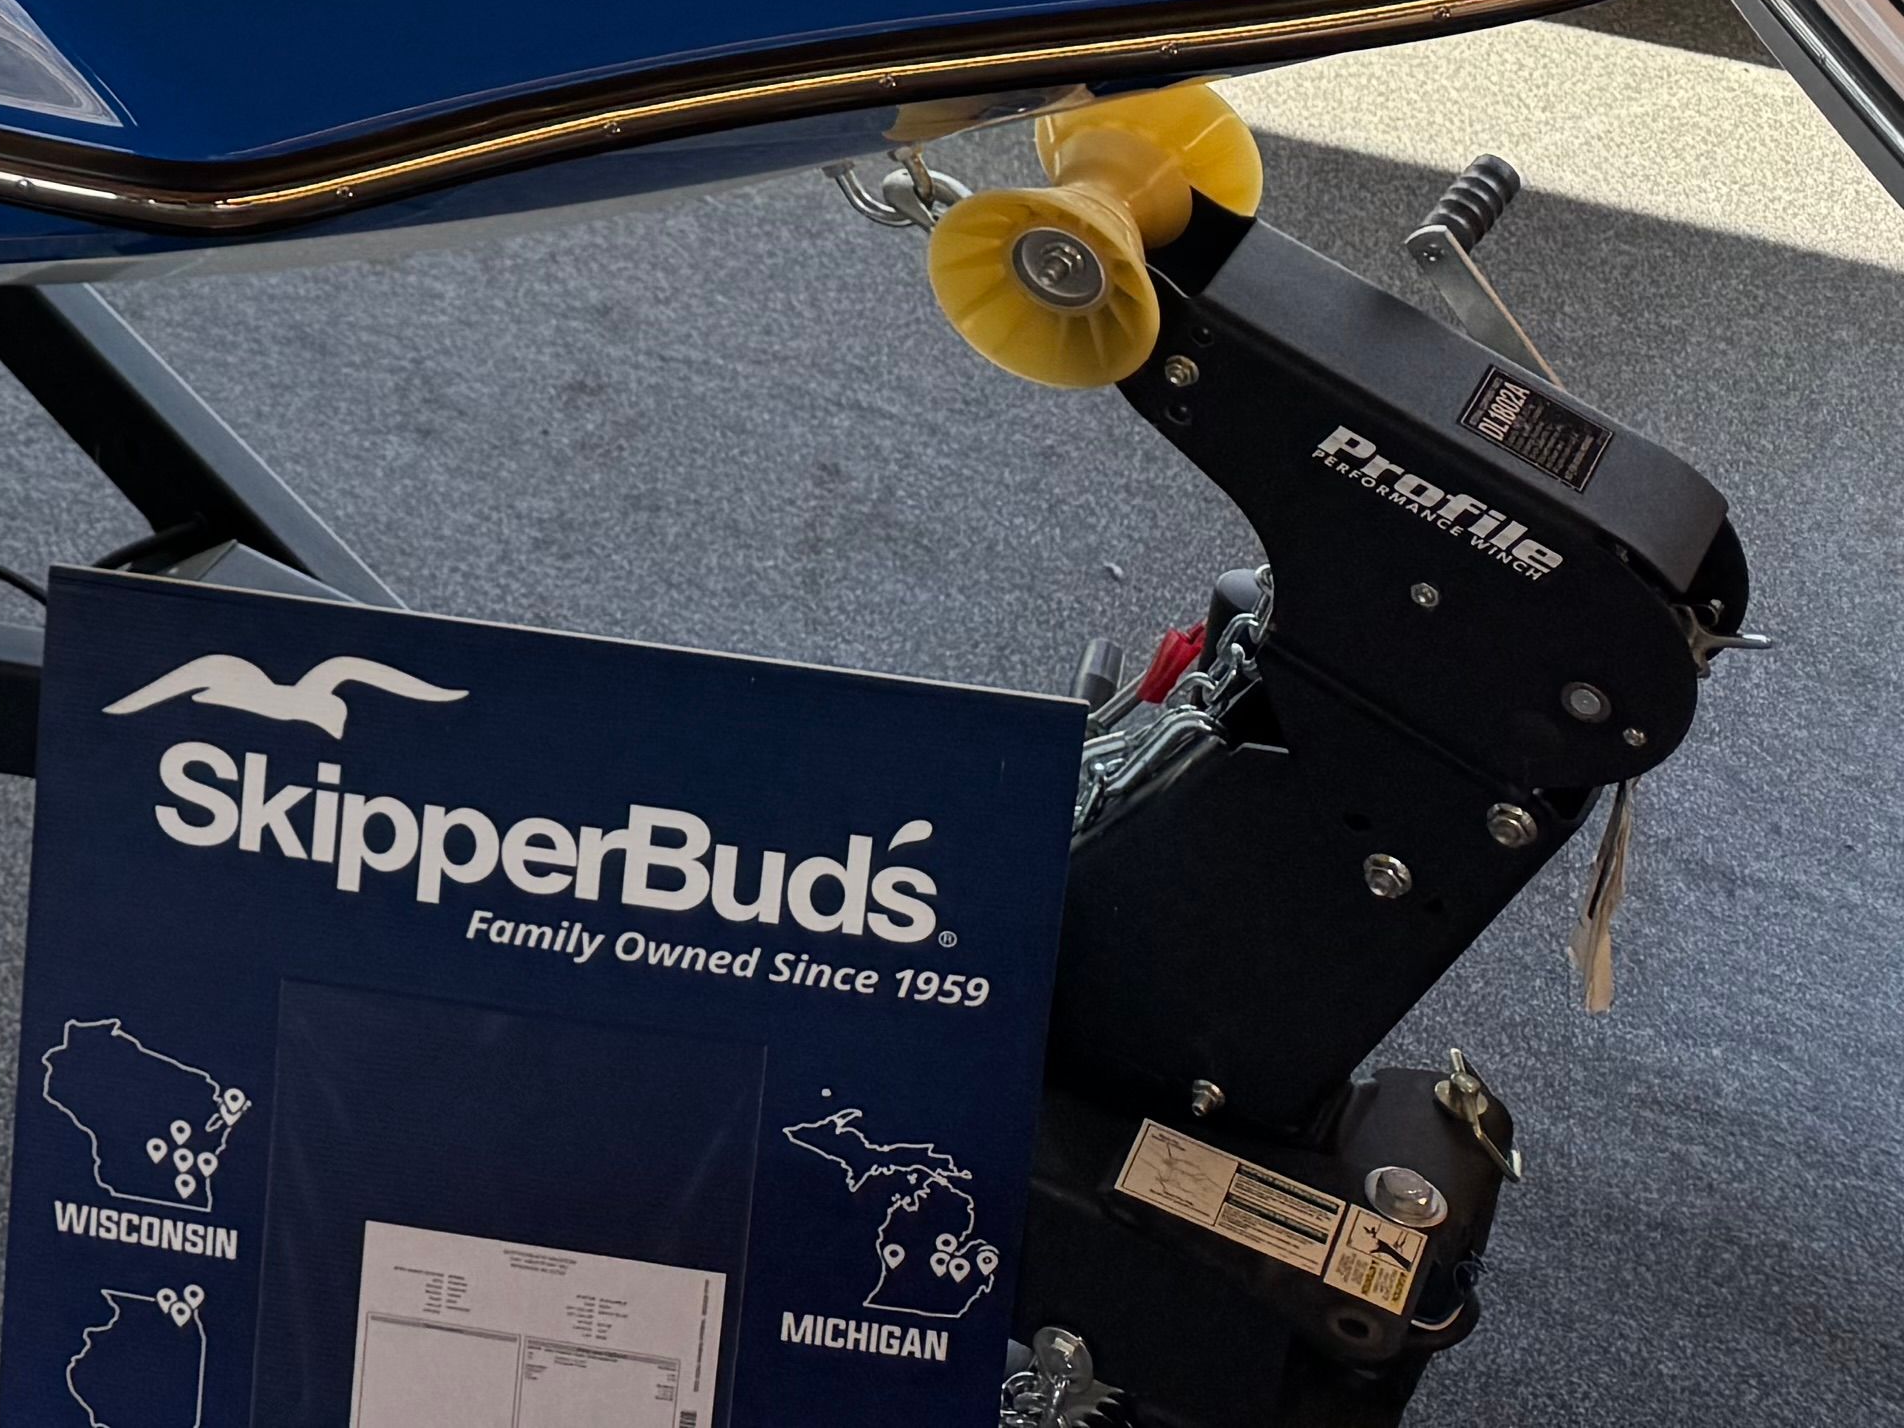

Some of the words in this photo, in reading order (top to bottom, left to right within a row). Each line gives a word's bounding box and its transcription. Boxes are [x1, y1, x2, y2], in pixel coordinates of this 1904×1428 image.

[1478, 381, 1531, 442] DL1802A
[1311, 449, 1464, 537] PERFORMANCE
[1470, 535, 1543, 581] WINCH
[1318, 425, 1564, 574] Profile
[465, 909, 606, 963] Family
[614, 930, 761, 978] Owned
[768, 952, 880, 994] Since
[893, 968, 991, 1008] 1959
[53, 1200, 238, 1260] WISCONSIN
[780, 1311, 949, 1362] MICHIGAN
